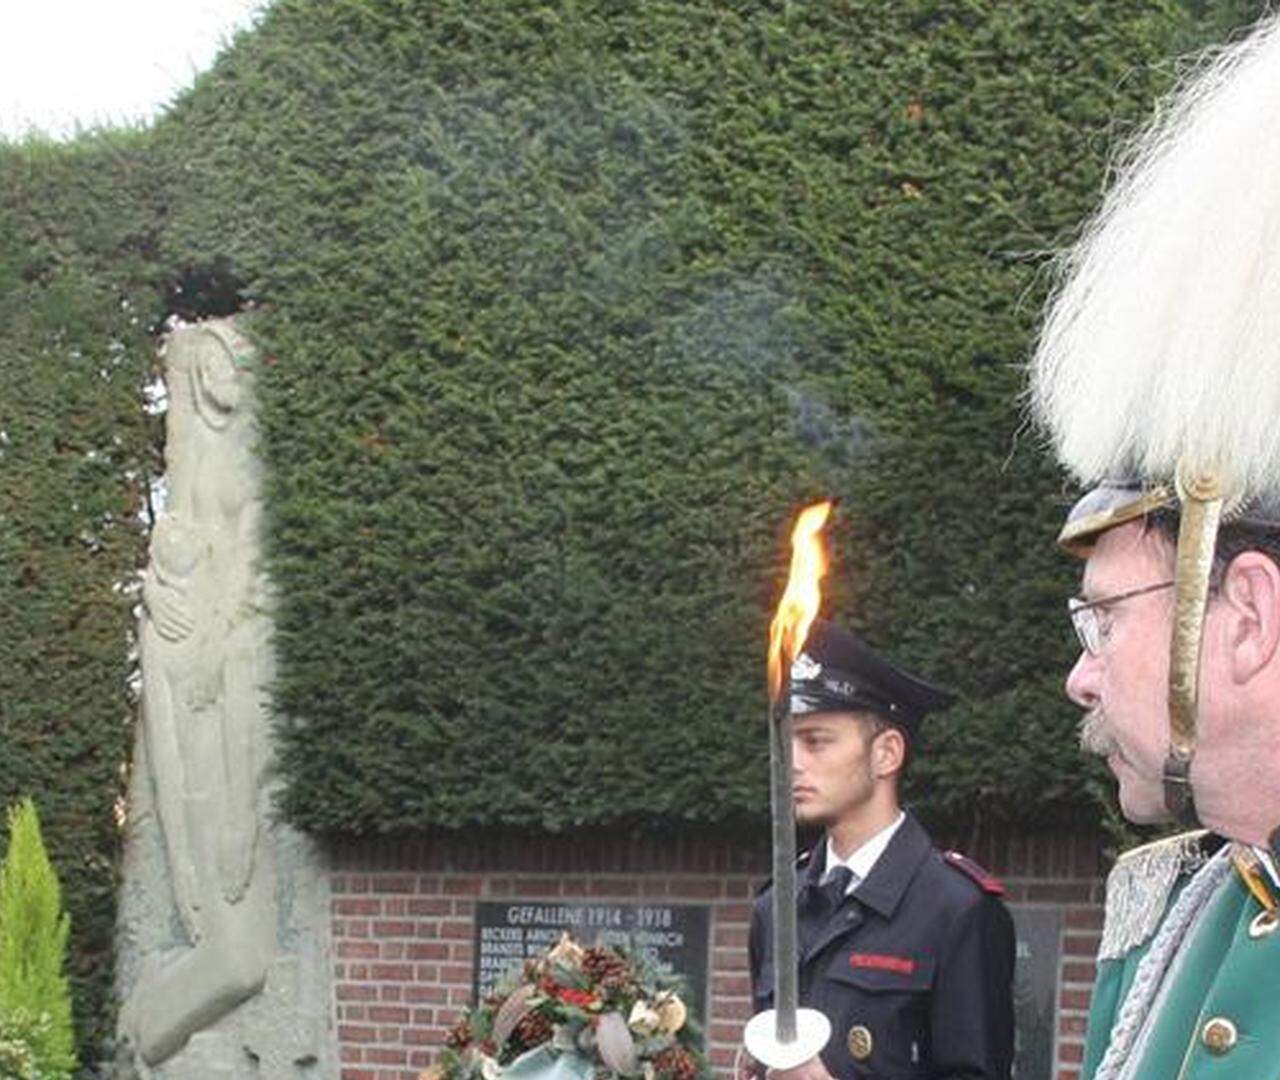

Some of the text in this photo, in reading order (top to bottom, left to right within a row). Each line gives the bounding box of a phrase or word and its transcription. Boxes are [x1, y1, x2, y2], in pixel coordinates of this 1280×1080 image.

[507, 905, 583, 926] GEFALLENE
[587, 907, 621, 926] 1914
[638, 908, 672, 928] 1918
